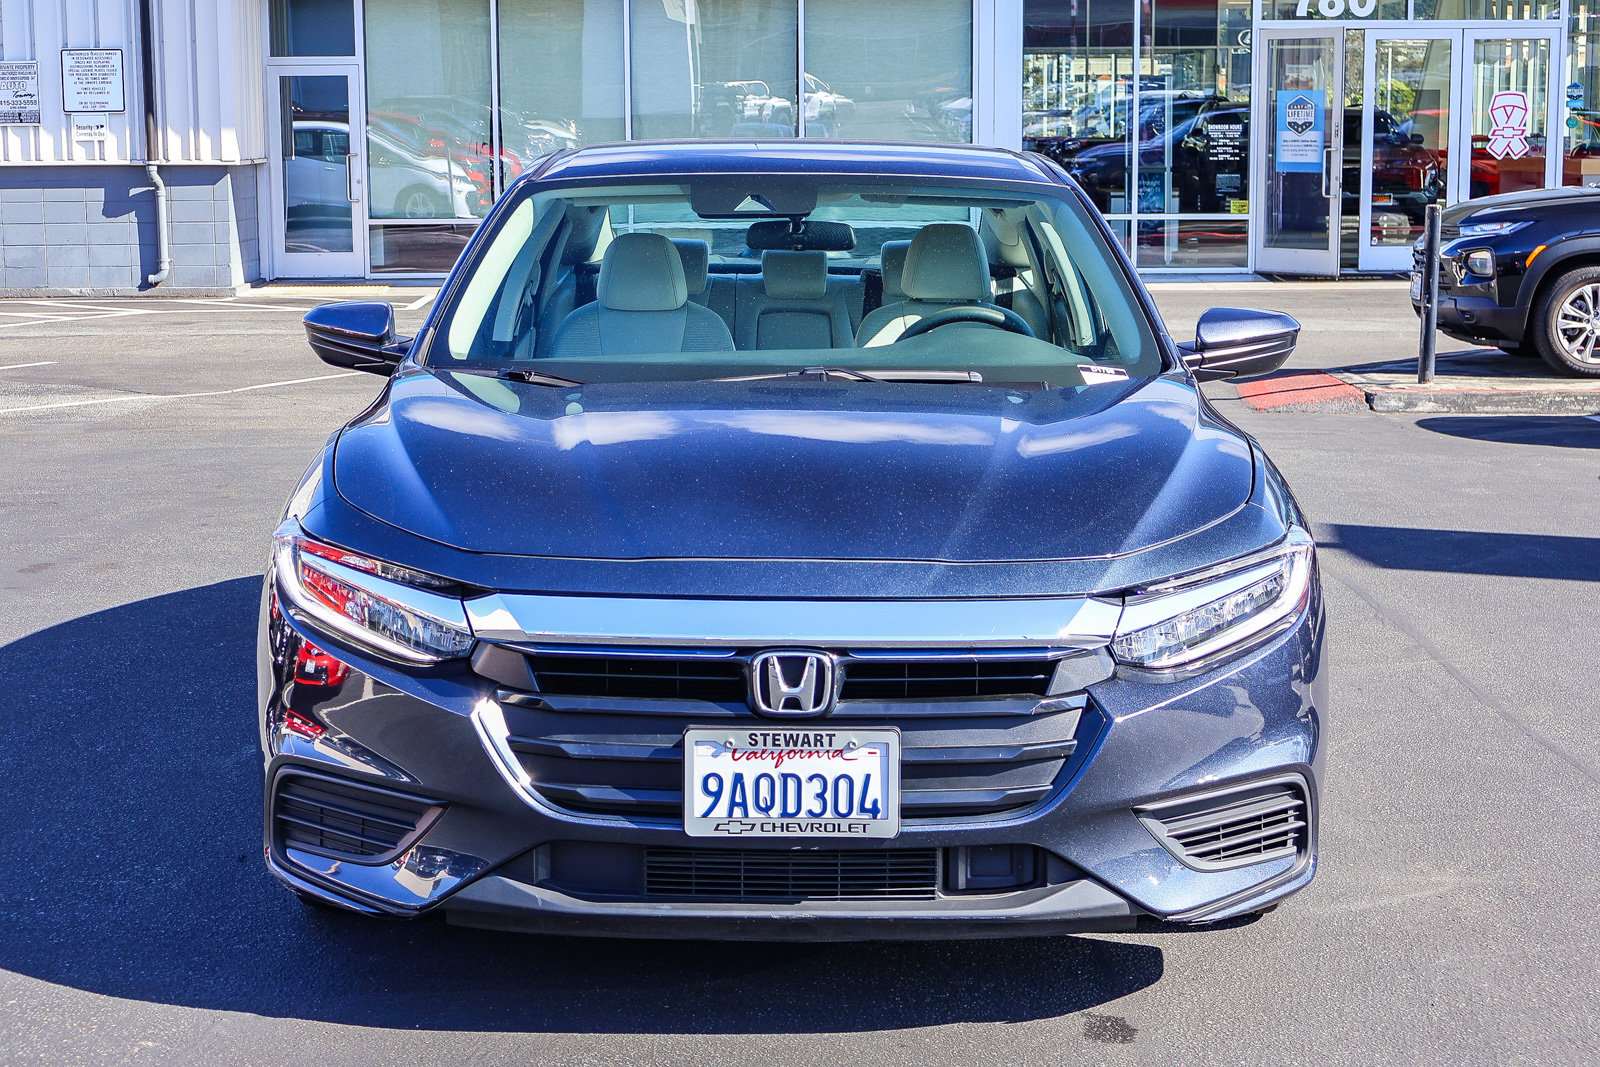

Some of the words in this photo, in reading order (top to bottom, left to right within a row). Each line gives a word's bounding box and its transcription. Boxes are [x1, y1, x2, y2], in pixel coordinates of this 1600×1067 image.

[0, 80, 27, 90] AUTO
[748, 733, 836, 748] STEWART
[731, 748, 858, 769] California
[701, 772, 881, 819] 9AQD304
[760, 822, 871, 834] CHEVROLET
